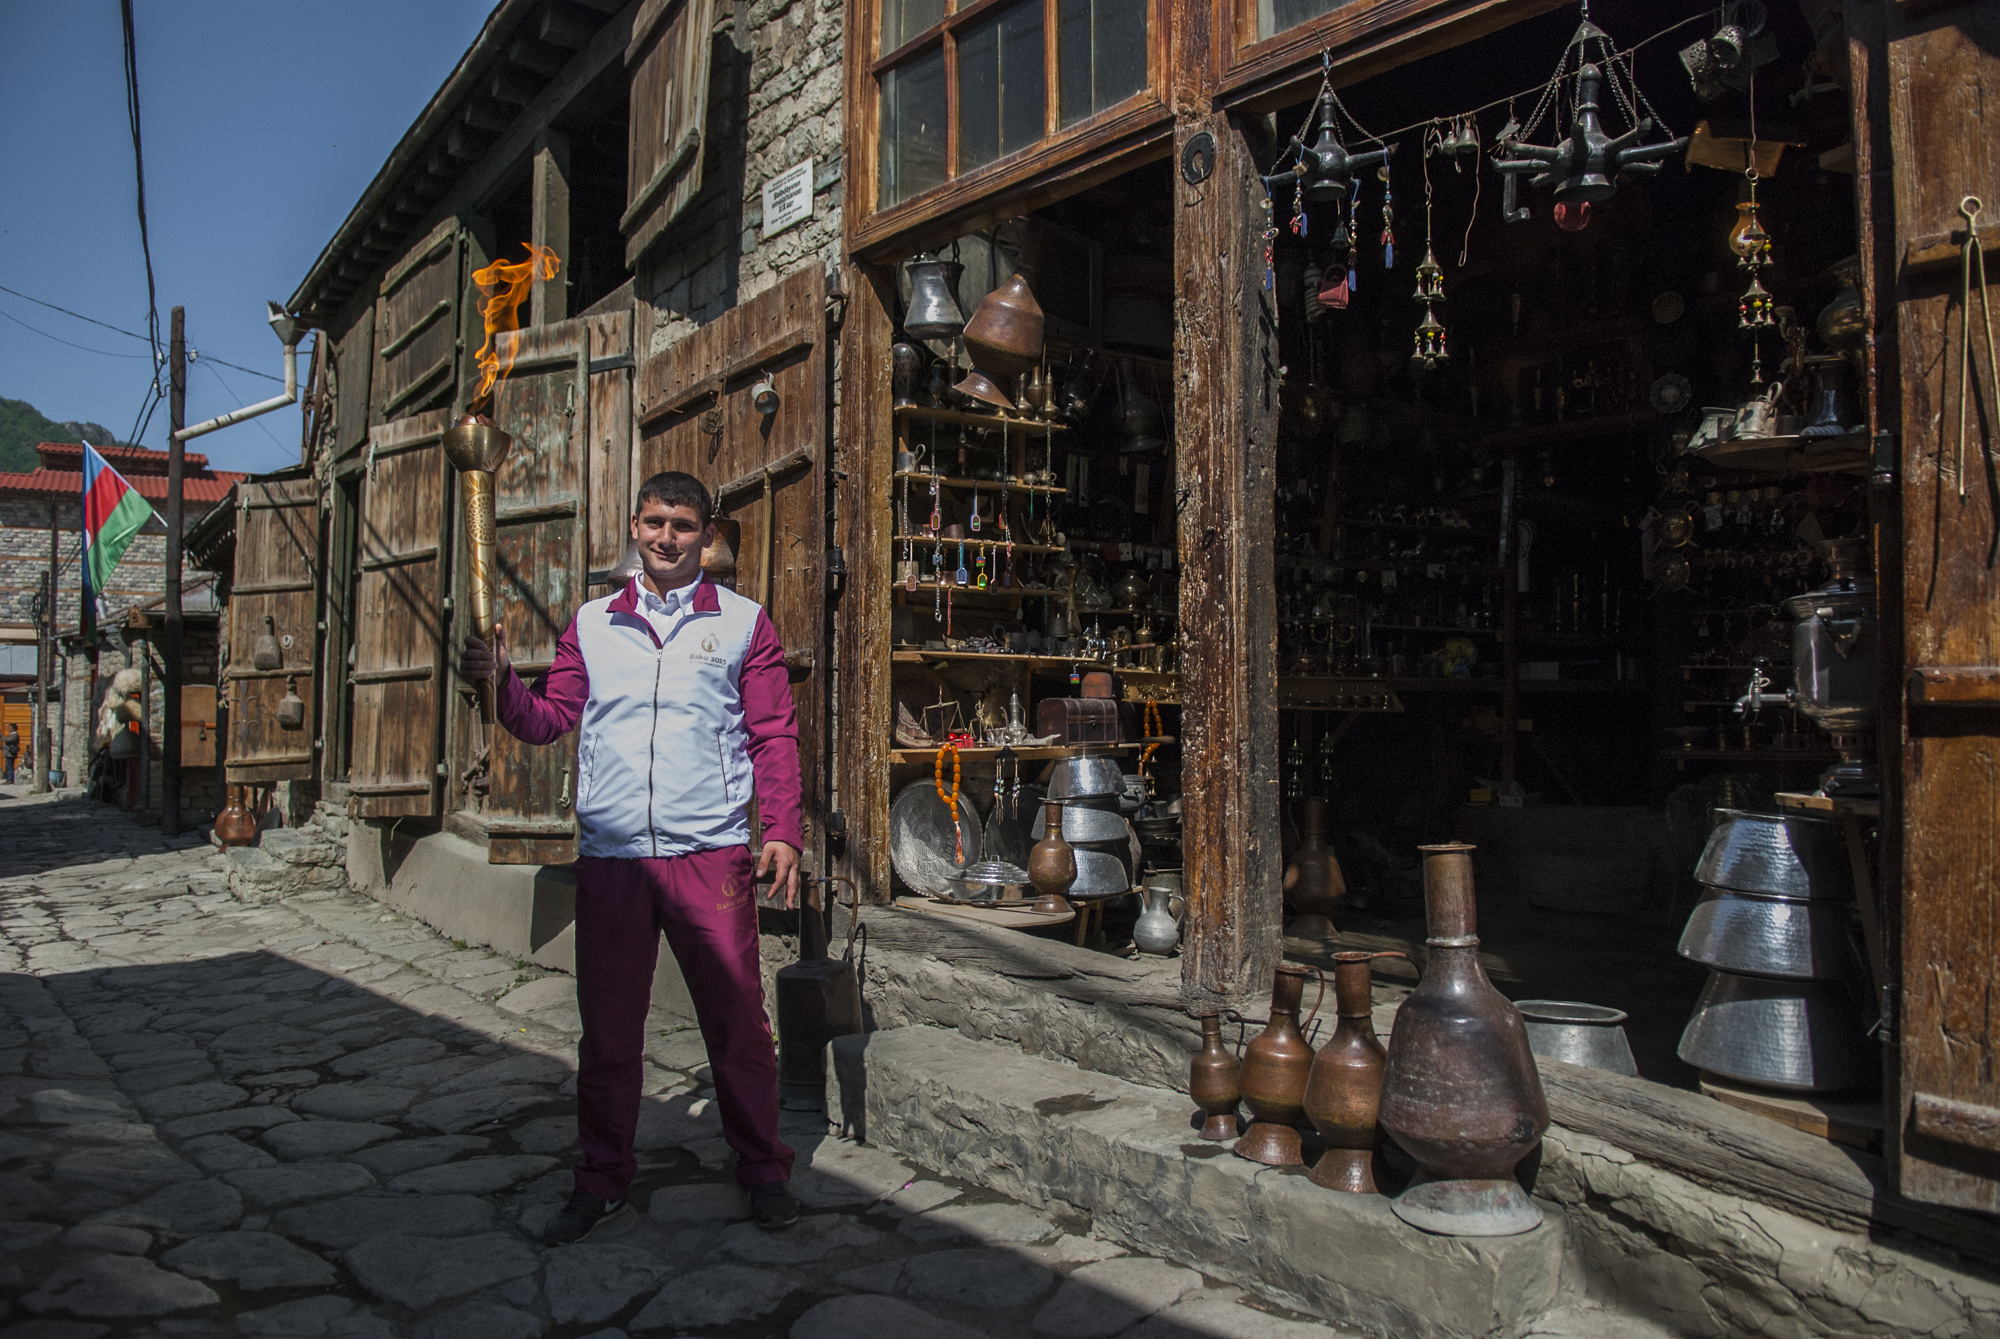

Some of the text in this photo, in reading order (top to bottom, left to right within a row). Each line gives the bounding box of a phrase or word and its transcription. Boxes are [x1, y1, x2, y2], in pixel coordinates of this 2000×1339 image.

[690, 653, 727, 665] Baku 2015
[716, 901, 735, 911] Baku
[736, 894, 749, 904] 2015
